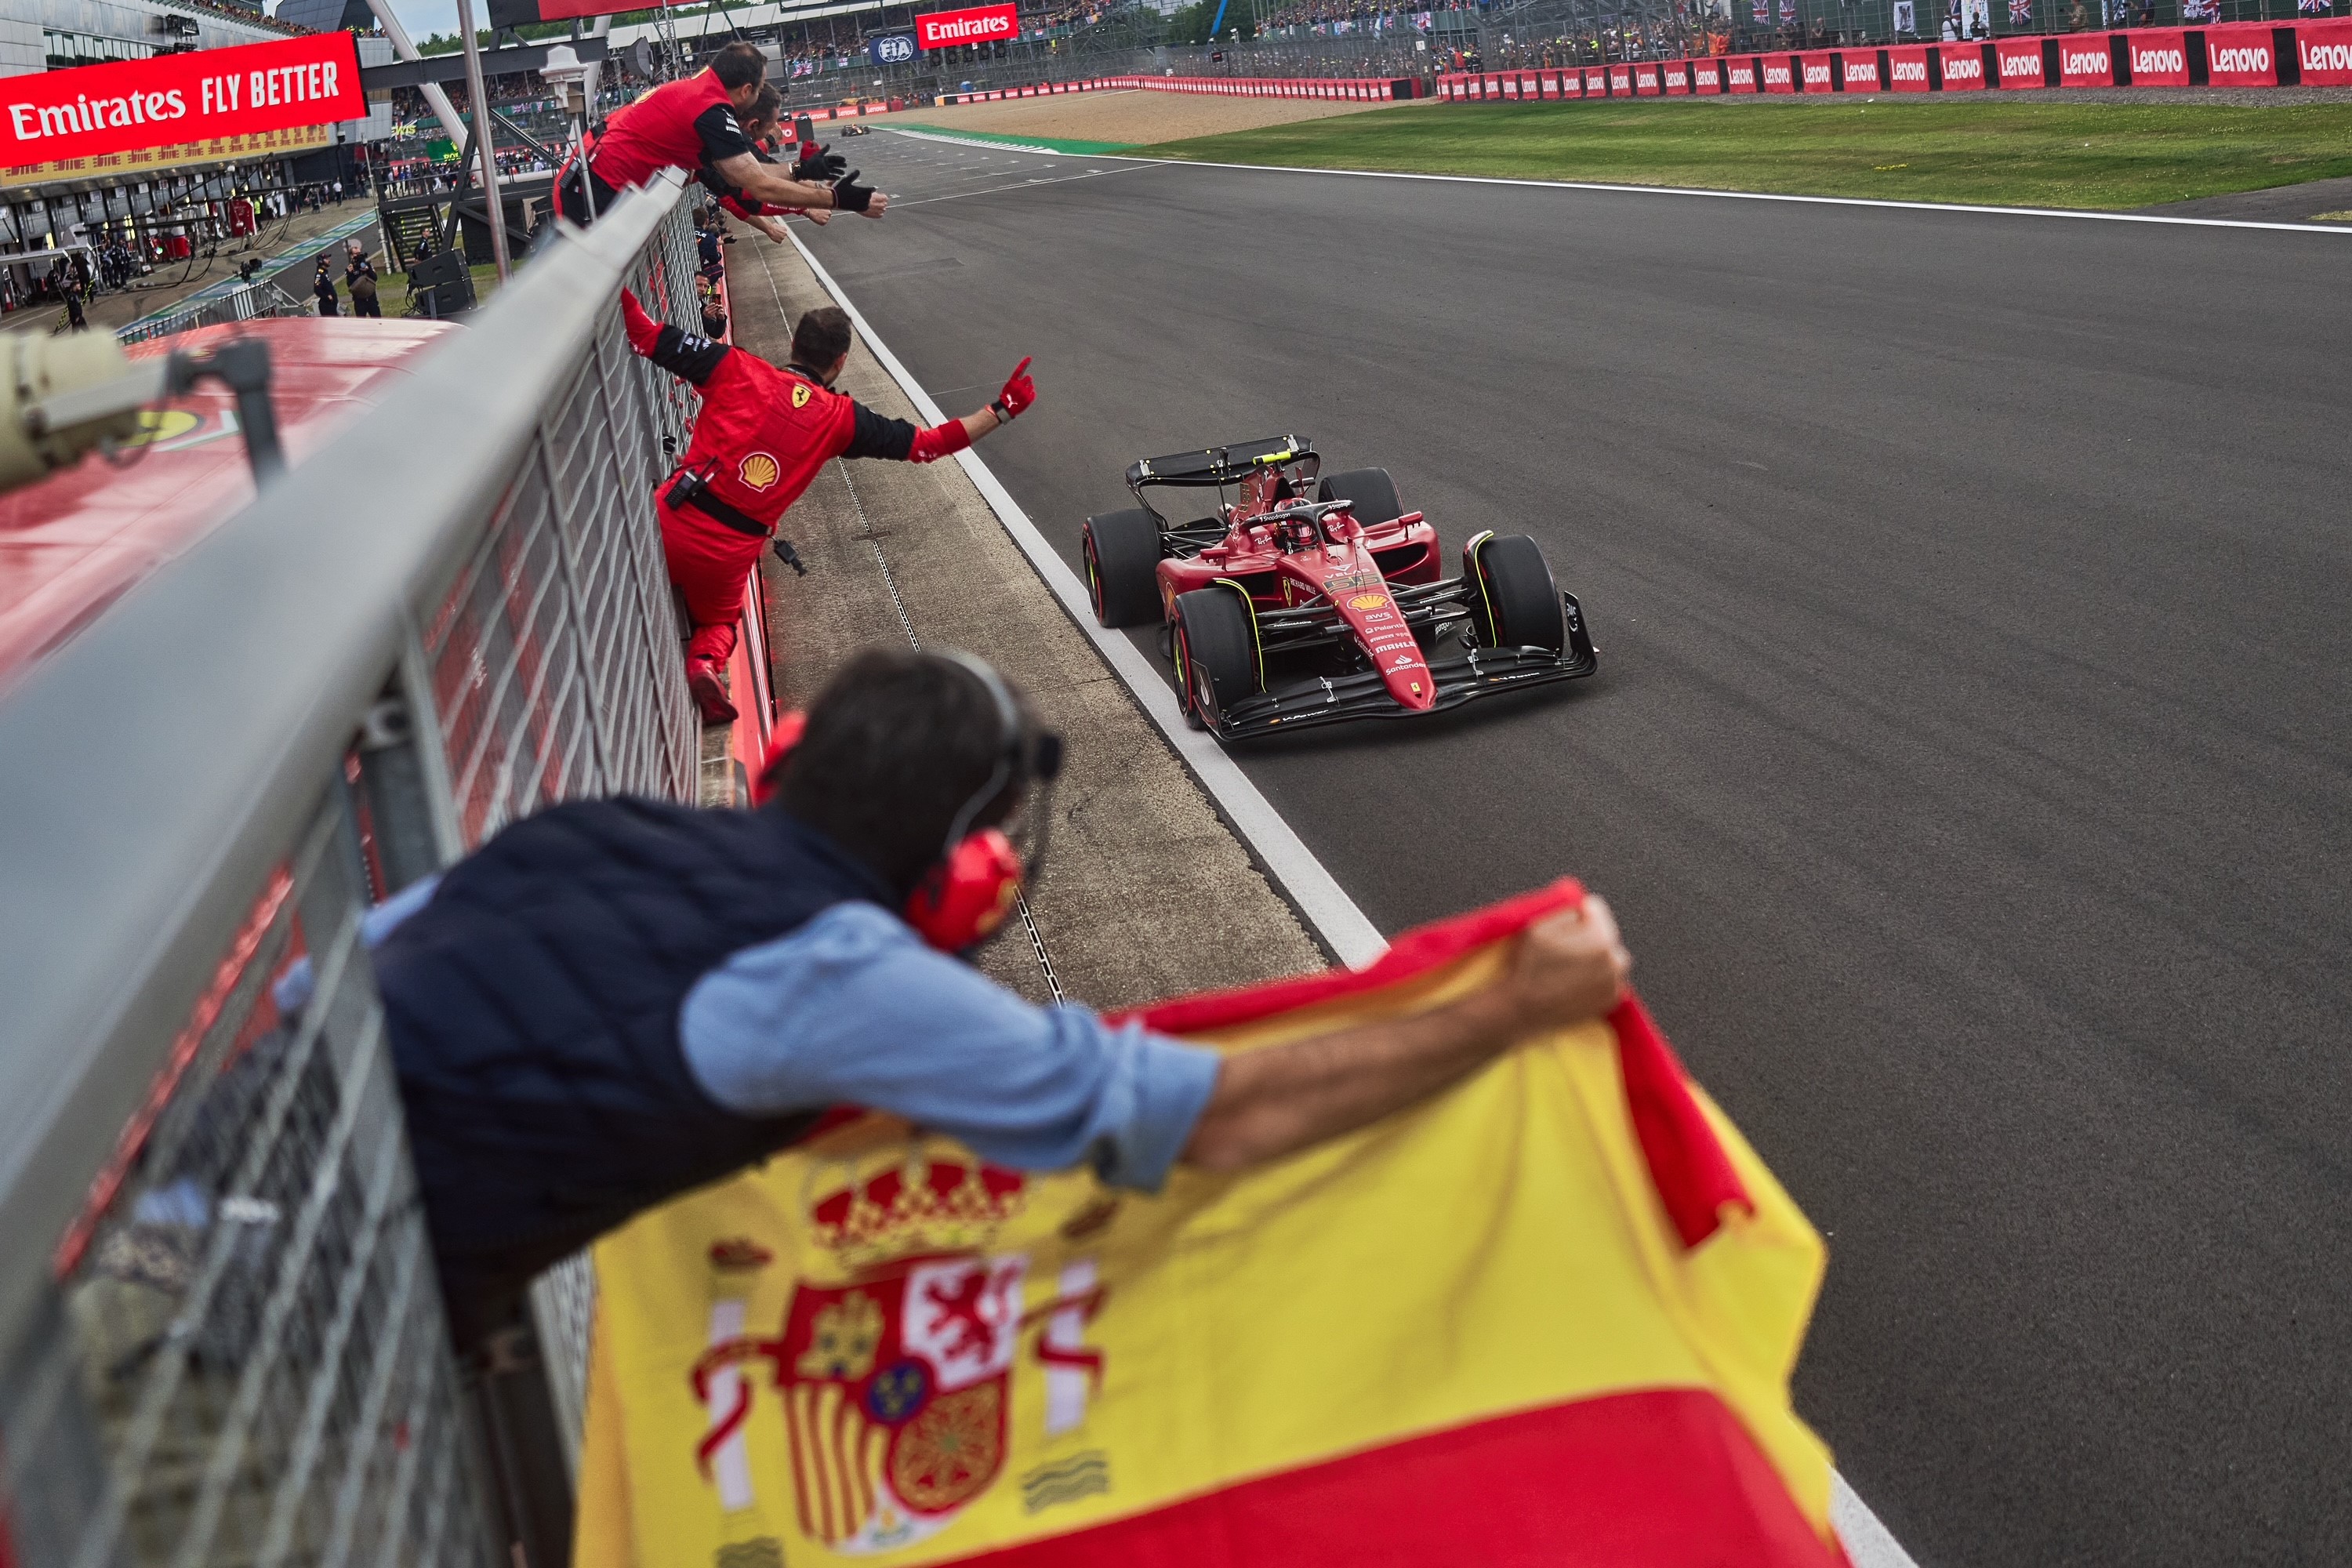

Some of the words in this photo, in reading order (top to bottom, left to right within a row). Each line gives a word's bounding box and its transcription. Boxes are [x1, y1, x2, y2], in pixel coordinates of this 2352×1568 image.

[926, 16, 1009, 41] Emirates
[2063, 49, 2107, 74] Lenovo
[2132, 45, 2182, 73] Lenovo
[2210, 43, 2269, 72] Lenovo
[2300, 40, 2352, 71] Lenov
[1763, 64, 1790, 84] Lenovo
[1803, 63, 1829, 82] Lenovo
[1845, 61, 1876, 82] Lenovo
[1891, 59, 1925, 81] Lenovo
[1942, 56, 1980, 79] Lenovo
[1999, 53, 2039, 77] Lenovo
[1563, 76, 1579, 91] Lenovo
[1586, 74, 1604, 90] Lenovo
[1610, 74, 1629, 89] Lenovo
[1636, 71, 1657, 88] Lenovo
[1664, 70, 1686, 87] Lenovo
[1694, 68, 1718, 86] Lenovo
[1727, 67, 1753, 85] Lenovo
[8, 89, 187, 140] Emirates
[201, 74, 241, 115] FLY
[250, 60, 339, 109] BETTER
[866, 104, 887, 113] Lenovo
[443, 153, 462, 162] ROL
[1263, 512, 1291, 522] Snapdragon
[1324, 568, 1370, 579] VELAS
[1290, 577, 1305, 591] RICHARD
[1305, 584, 1316, 595] MILLE
[1322, 573, 1378, 596] 55
[1365, 612, 1392, 621] aws
[1375, 641, 1417, 654] MAHLE
[1386, 662, 1427, 676] Santander
